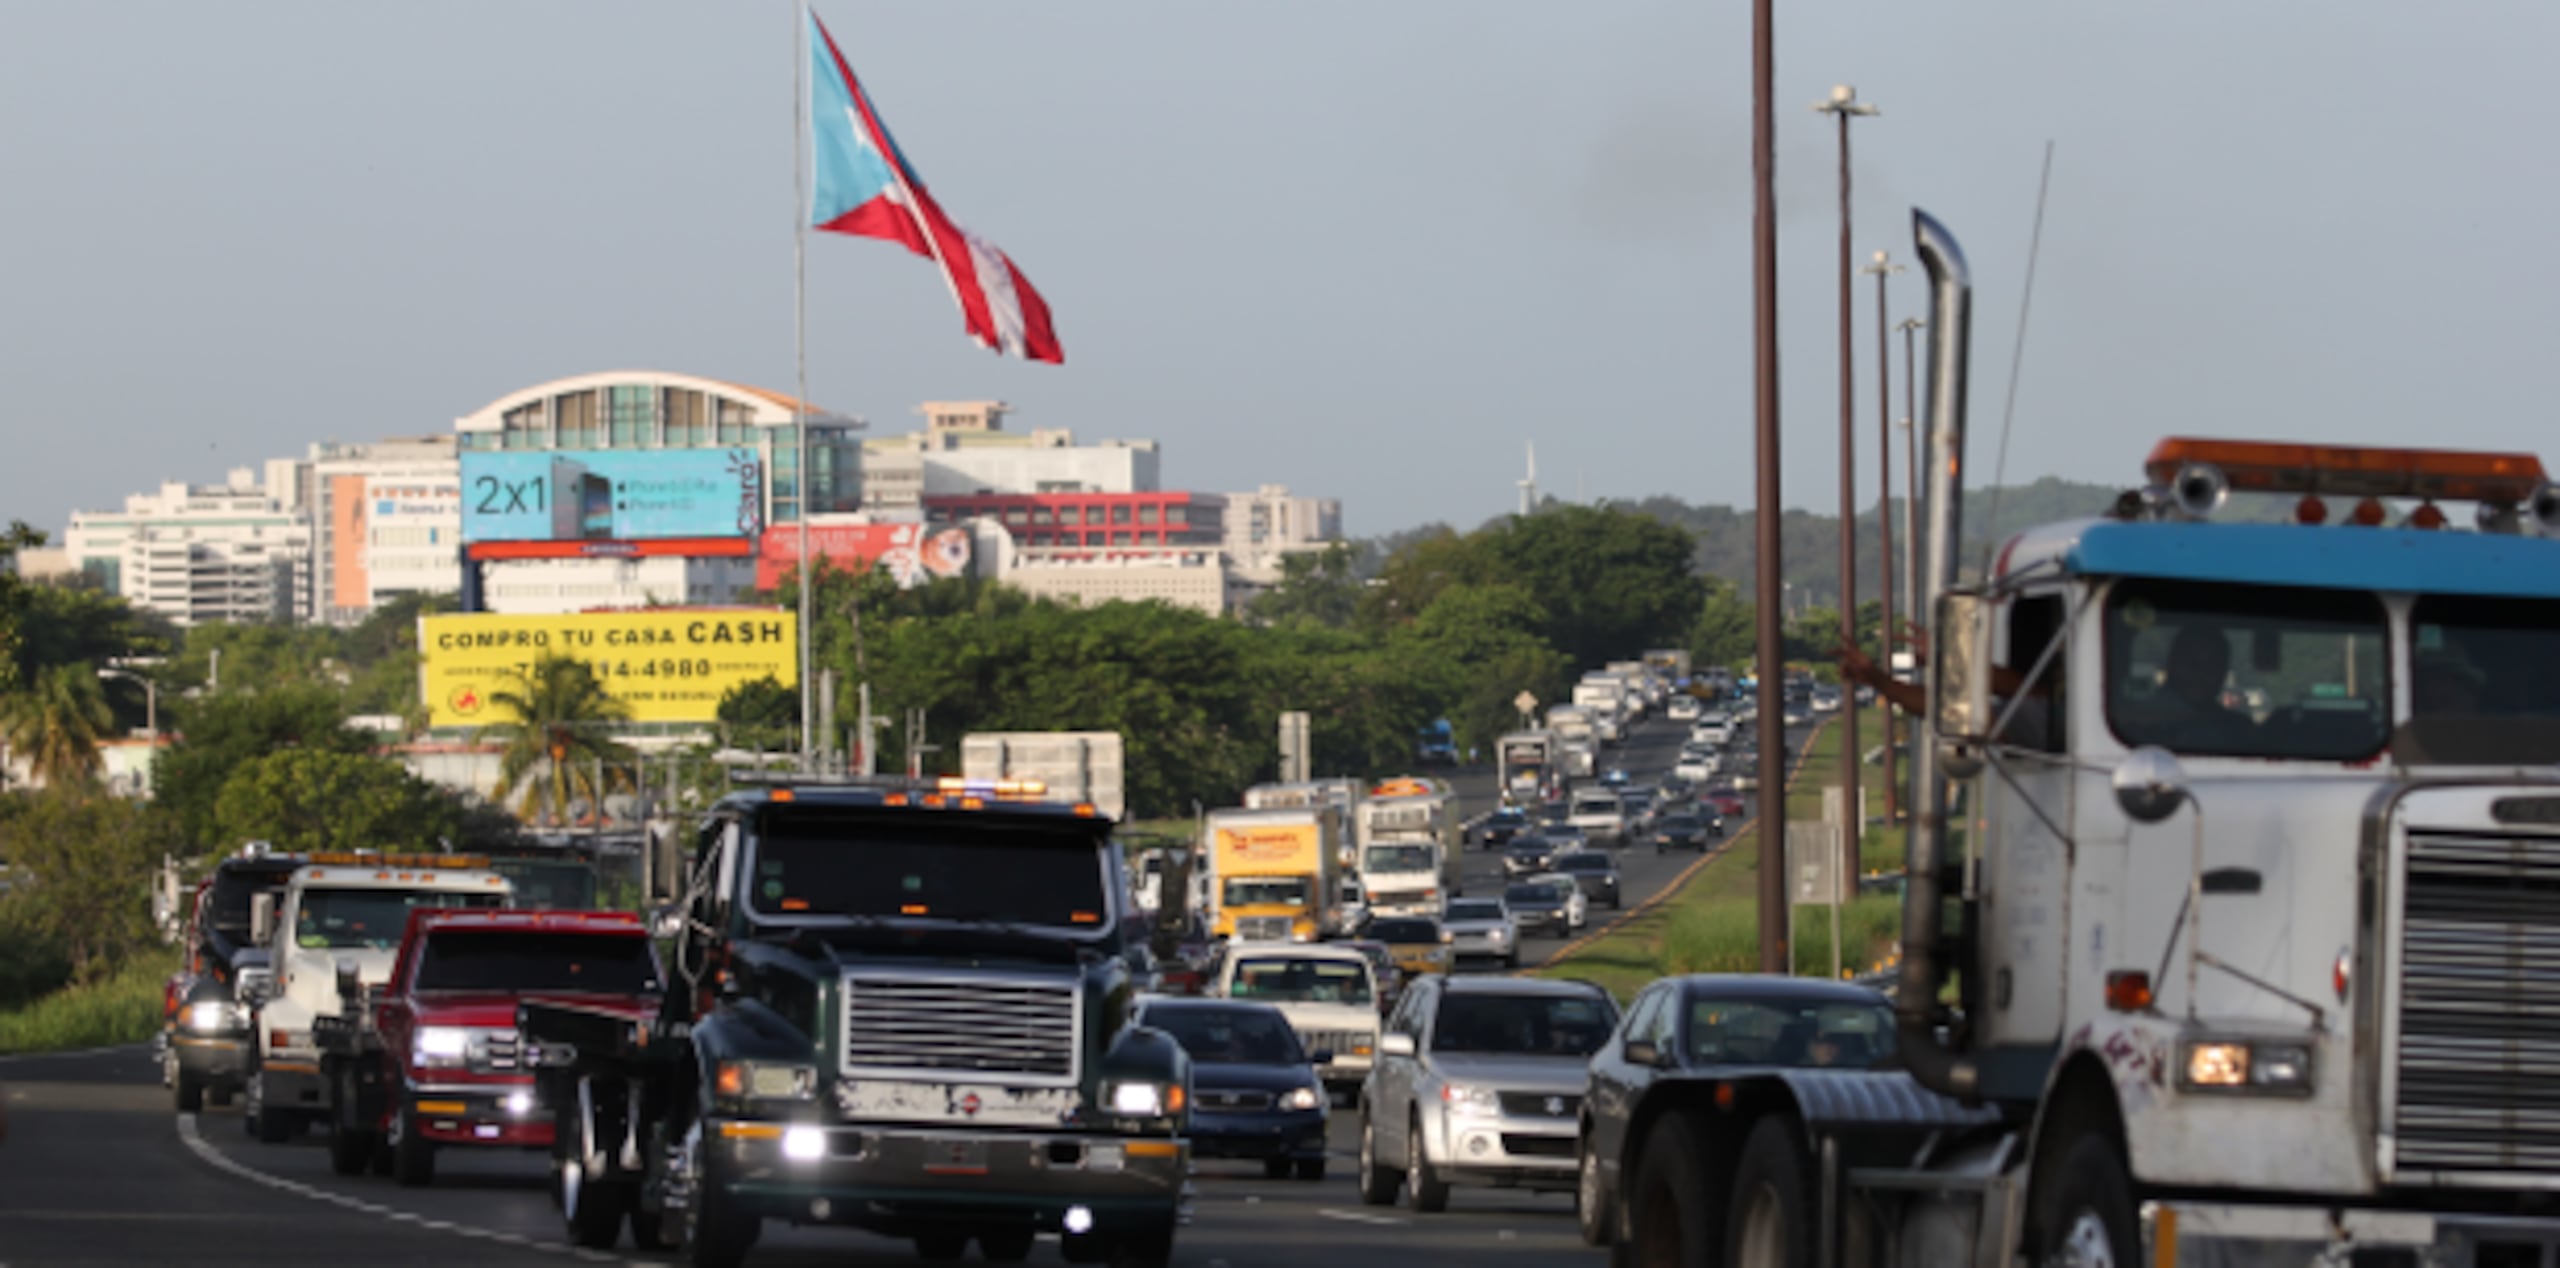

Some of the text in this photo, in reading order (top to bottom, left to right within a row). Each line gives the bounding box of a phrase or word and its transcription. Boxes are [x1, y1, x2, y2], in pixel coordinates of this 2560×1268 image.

[475, 475, 545, 515] 2x1
[438, 621, 783, 649] COMPRO TU CASA CASH
